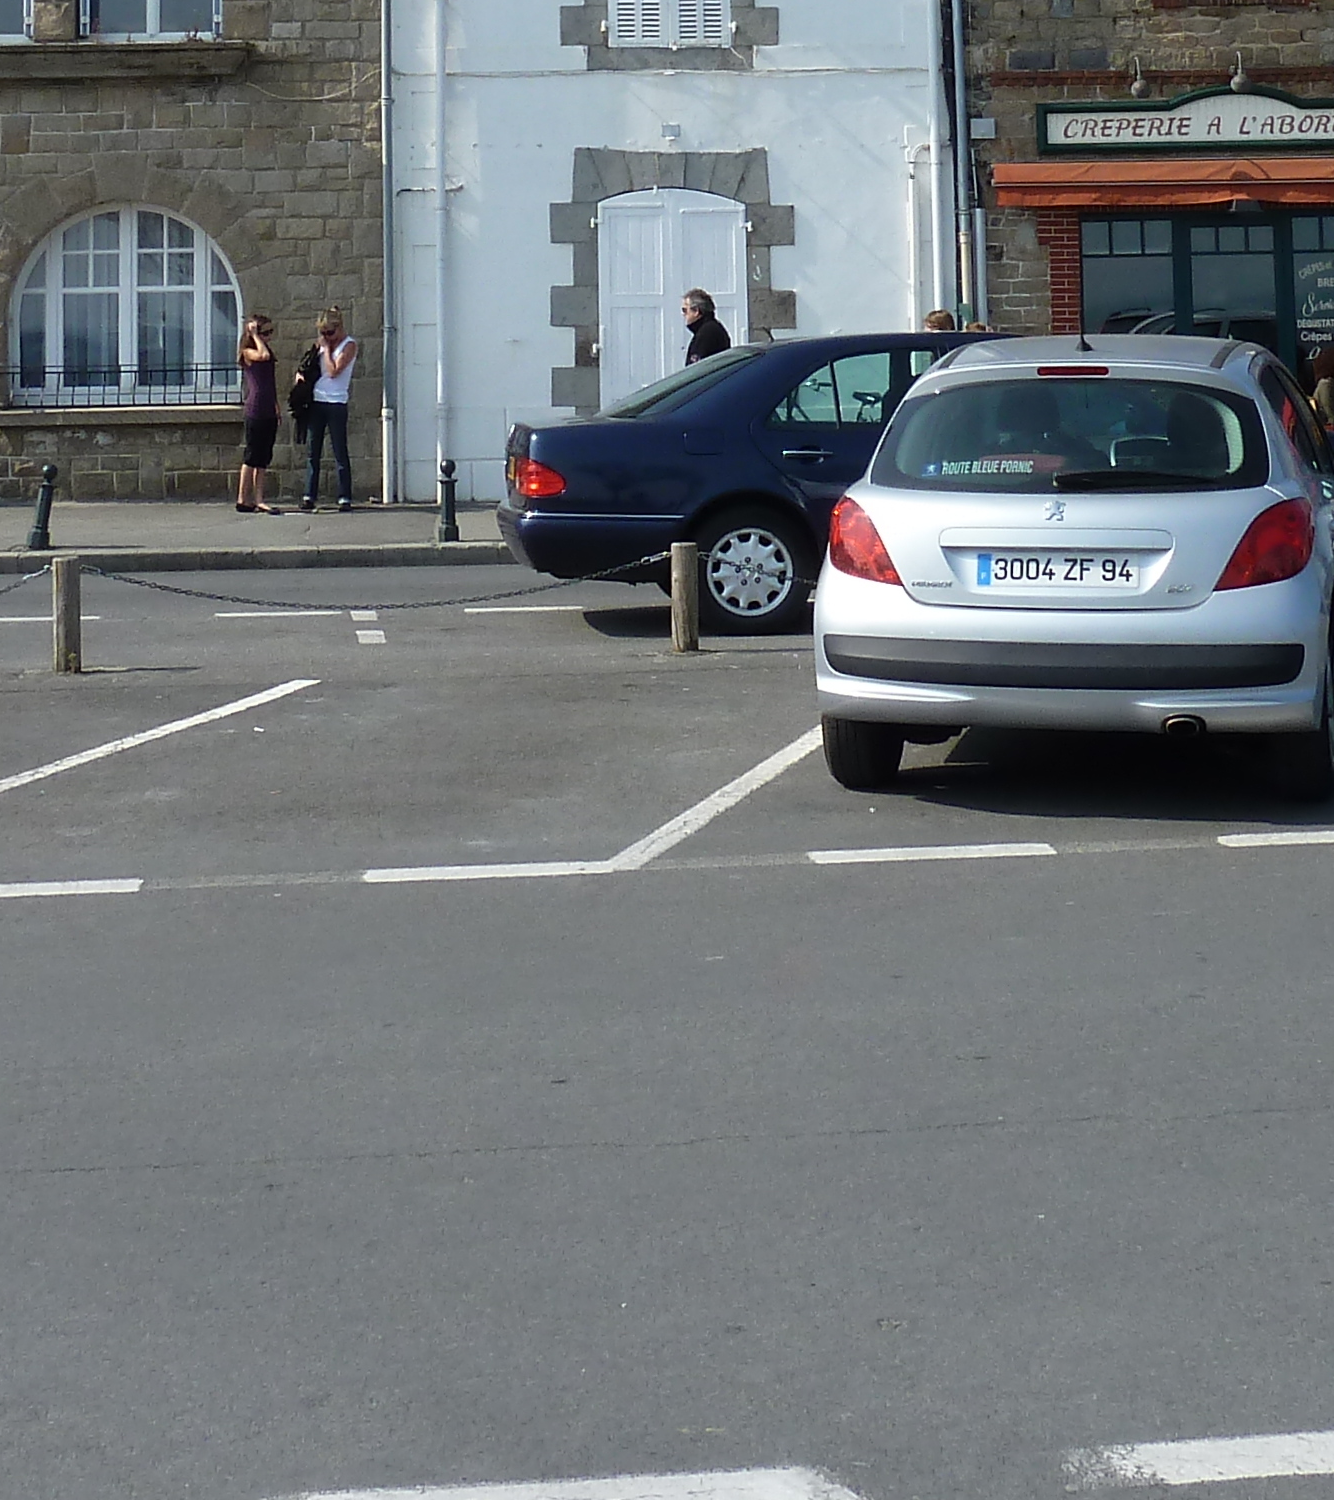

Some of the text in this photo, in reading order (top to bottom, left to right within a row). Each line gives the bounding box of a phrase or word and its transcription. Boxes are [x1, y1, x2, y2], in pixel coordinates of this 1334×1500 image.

[1062, 116, 1192, 139] CREPERIE
[1206, 116, 1223, 135] A
[941, 460, 1034, 476] ROUTE BLEUE PORNIC
[993, 558, 1056, 581] 3004
[1063, 558, 1095, 581] ZF
[1101, 559, 1133, 582] 94
